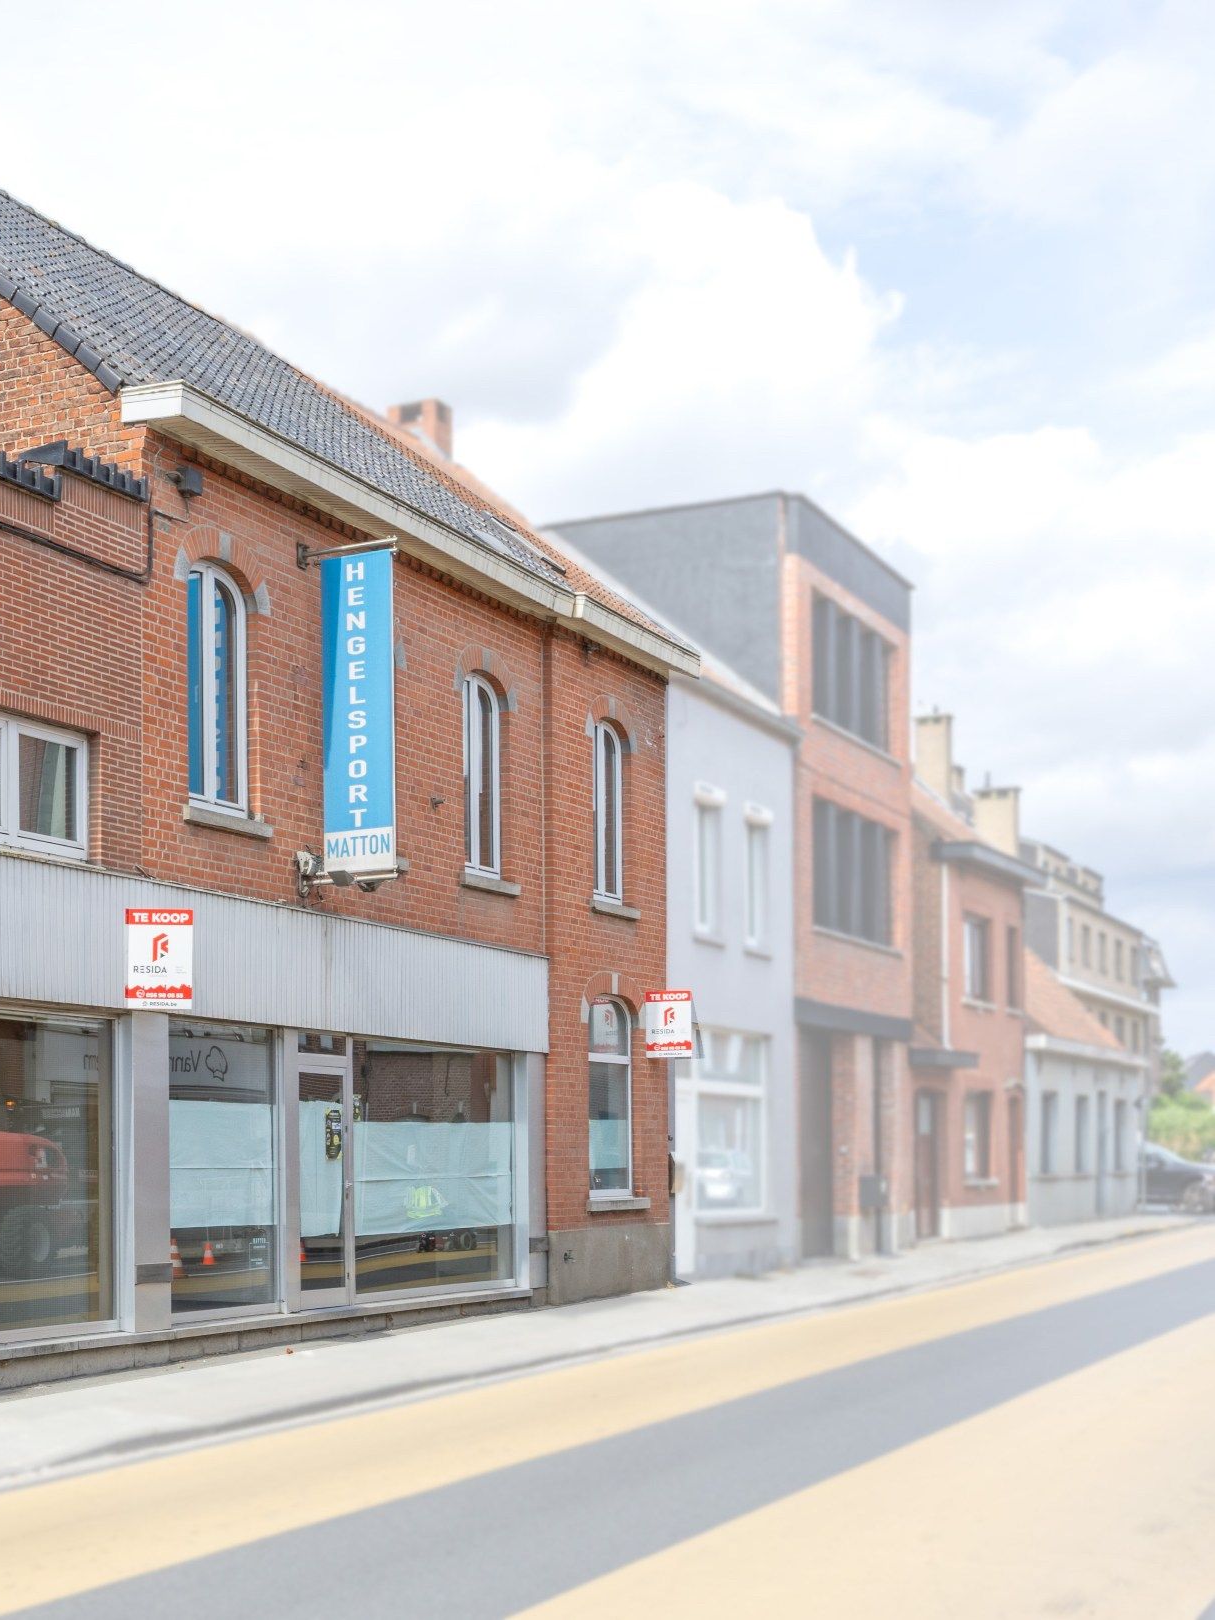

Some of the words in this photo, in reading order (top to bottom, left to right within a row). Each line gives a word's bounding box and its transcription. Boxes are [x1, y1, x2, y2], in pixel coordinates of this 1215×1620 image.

[346, 561, 369, 828] HENGELSPORT
[327, 833, 391, 859] MATTON
[132, 912, 149, 923] TE
[151, 912, 190, 923] KOOP
[133, 965, 168, 974] RESIDA
[650, 993, 661, 1001] TE
[663, 993, 689, 1001] KOOP
